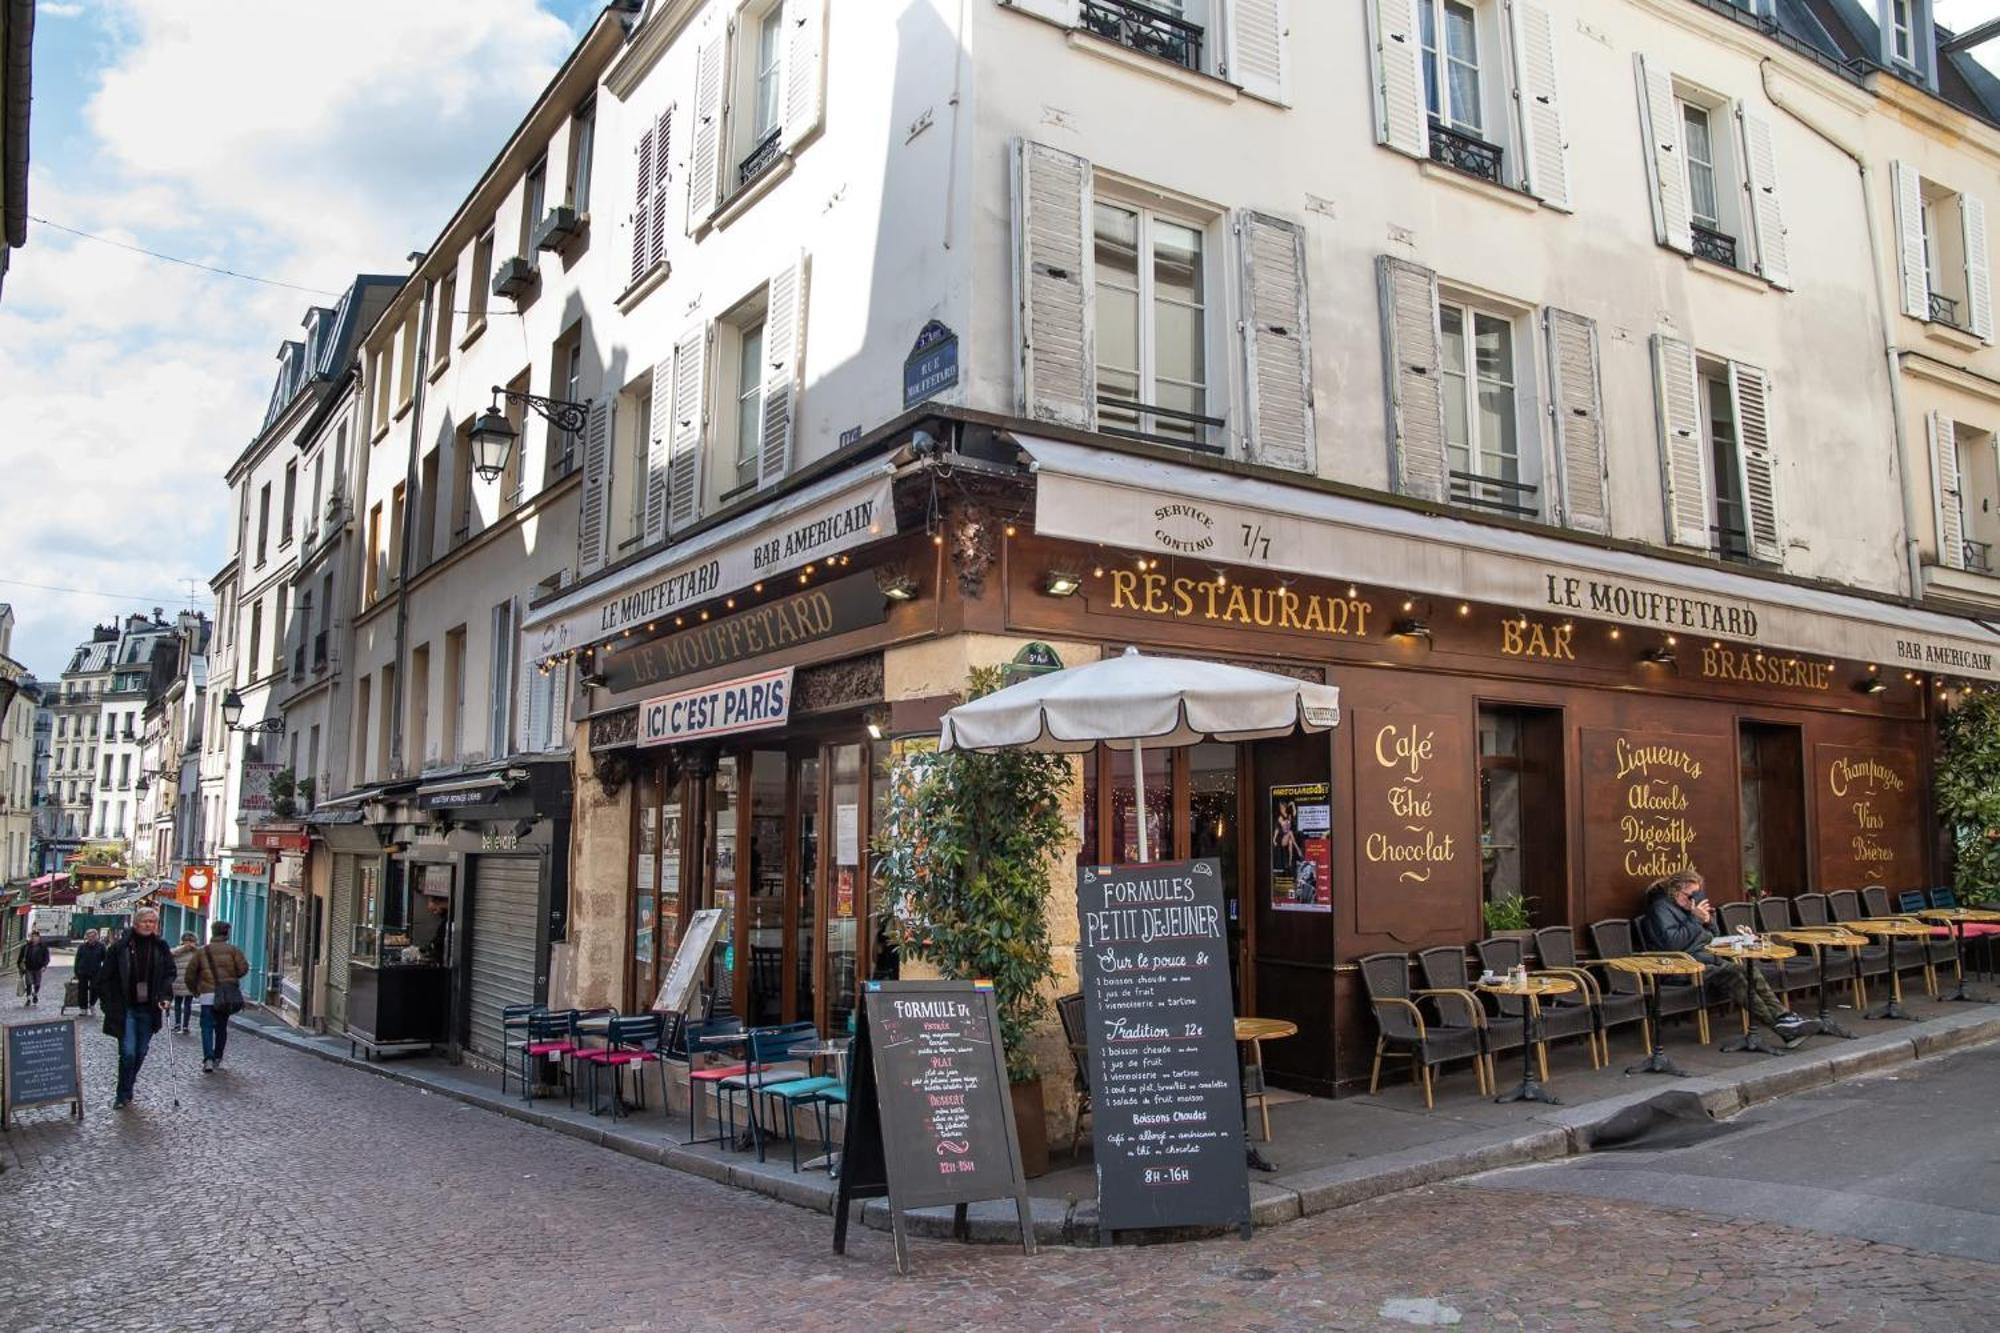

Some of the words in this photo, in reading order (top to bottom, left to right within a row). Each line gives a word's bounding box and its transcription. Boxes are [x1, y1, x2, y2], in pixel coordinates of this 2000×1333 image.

[907, 365, 956, 397] MOUFFETARD
[921, 356, 940, 376] RUE
[1154, 504, 1214, 529] SERVICE
[754, 539, 780, 569] BAR
[784, 500, 874, 558] AMERICAIN
[1154, 529, 1214, 552] CONTINU
[1241, 524, 1271, 560] 7/7
[601, 602, 618, 631] LE
[620, 559, 721, 626] MOUFFETARD
[1110, 569, 1372, 636] RESTAURANT
[1546, 574, 1582, 609] LE
[1589, 581, 1759, 638] MOUFFETARD
[630, 652, 657, 682] LE
[662, 591, 833, 674] MOUFFETARD
[1501, 619, 1575, 660] BAR
[1702, 648, 1829, 690] BRASSERIE
[1896, 640, 1922, 661] BAR
[1924, 644, 1992, 671] AMERICAIN
[647, 703, 666, 737] ICI
[671, 693, 719, 732] C'EST
[724, 680, 784, 725] PARIS
[1375, 724, 1434, 774] Café
[1616, 737, 1702, 779] Liqueurs
[1830, 757, 1904, 796] Champagne
[1387, 786, 1432, 817] Thé
[1628, 784, 1689, 810] Alcools
[1852, 801, 1884, 829] Vins
[1366, 831, 1454, 862] Chocolat
[1621, 815, 1697, 853] Digestifs
[1852, 836, 1894, 861] Bières
[1625, 850, 1697, 876] Cocktails
[1103, 878, 1195, 908] FORMULES
[1087, 910, 1137, 947] PETIT
[1141, 905, 1220, 943] DEJEUNER
[1097, 947, 1132, 972] Sur
[1138, 953, 1148, 968] le
[1152, 956, 1186, 971] pouce
[894, 1000, 957, 1018] FORMULE
[1105, 1017, 1169, 1040] Tradition
[1133, 1113, 1169, 1124] Boissons
[1173, 1110, 1207, 1121] Chaudes
